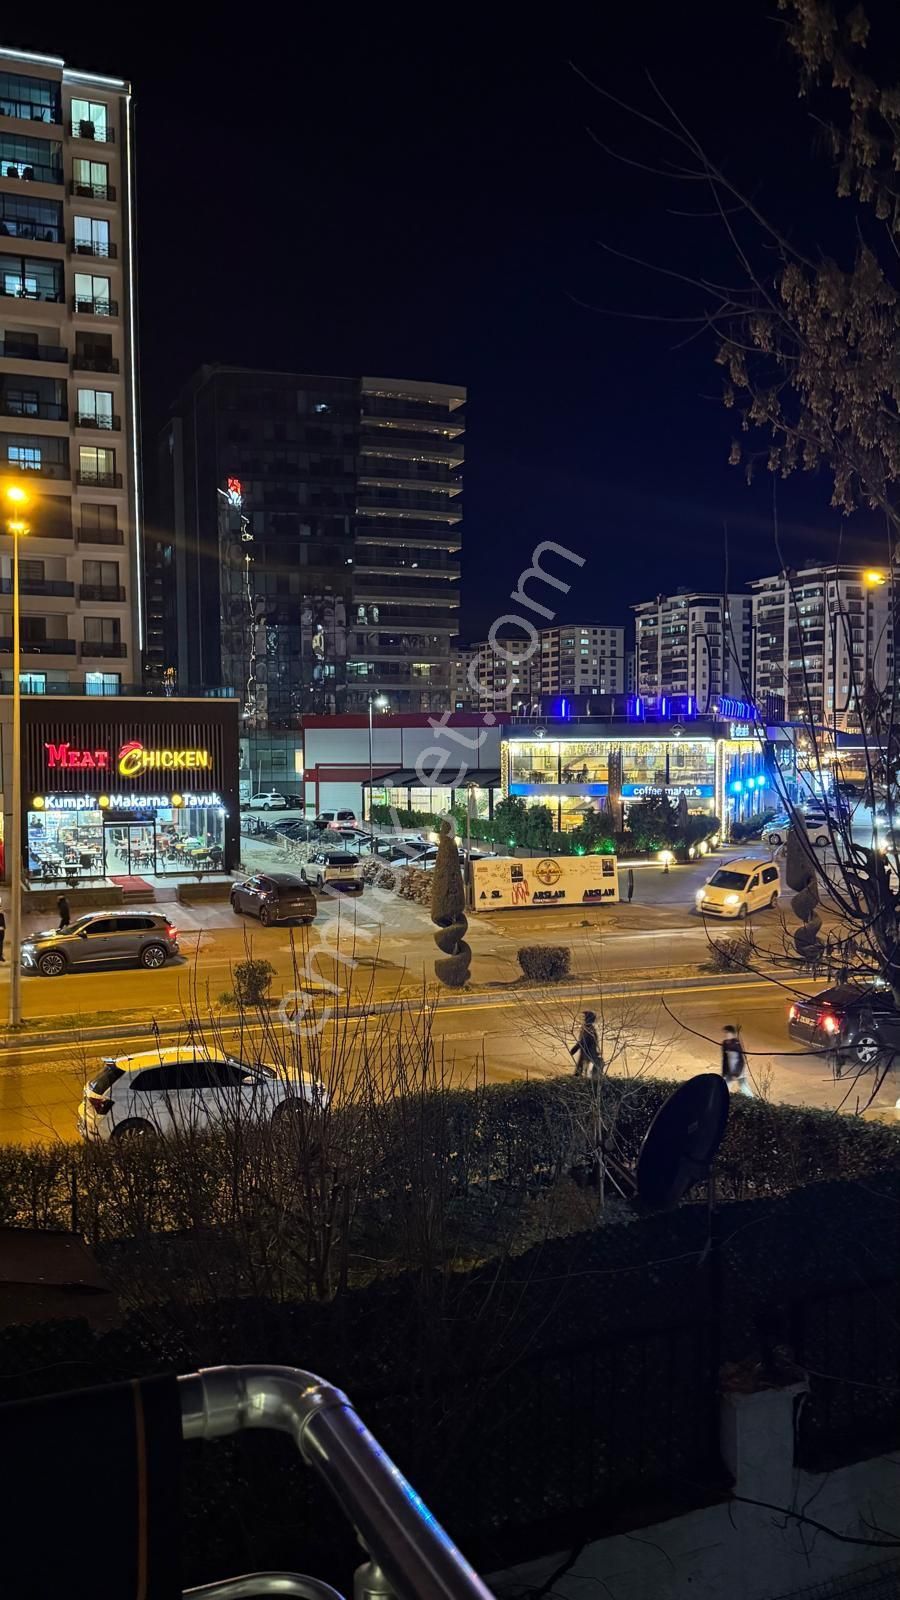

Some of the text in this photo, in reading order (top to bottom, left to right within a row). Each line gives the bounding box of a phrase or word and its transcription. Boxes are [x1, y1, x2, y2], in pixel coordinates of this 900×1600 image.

[45, 742, 208, 776] MEAT CHICKEN
[634, 786, 662, 797] coffee
[45, 793, 222, 811] Kumpir Makarna Tavuk
[533, 889, 565, 900] ARSLAN
[583, 887, 615, 899] ARSLAN
